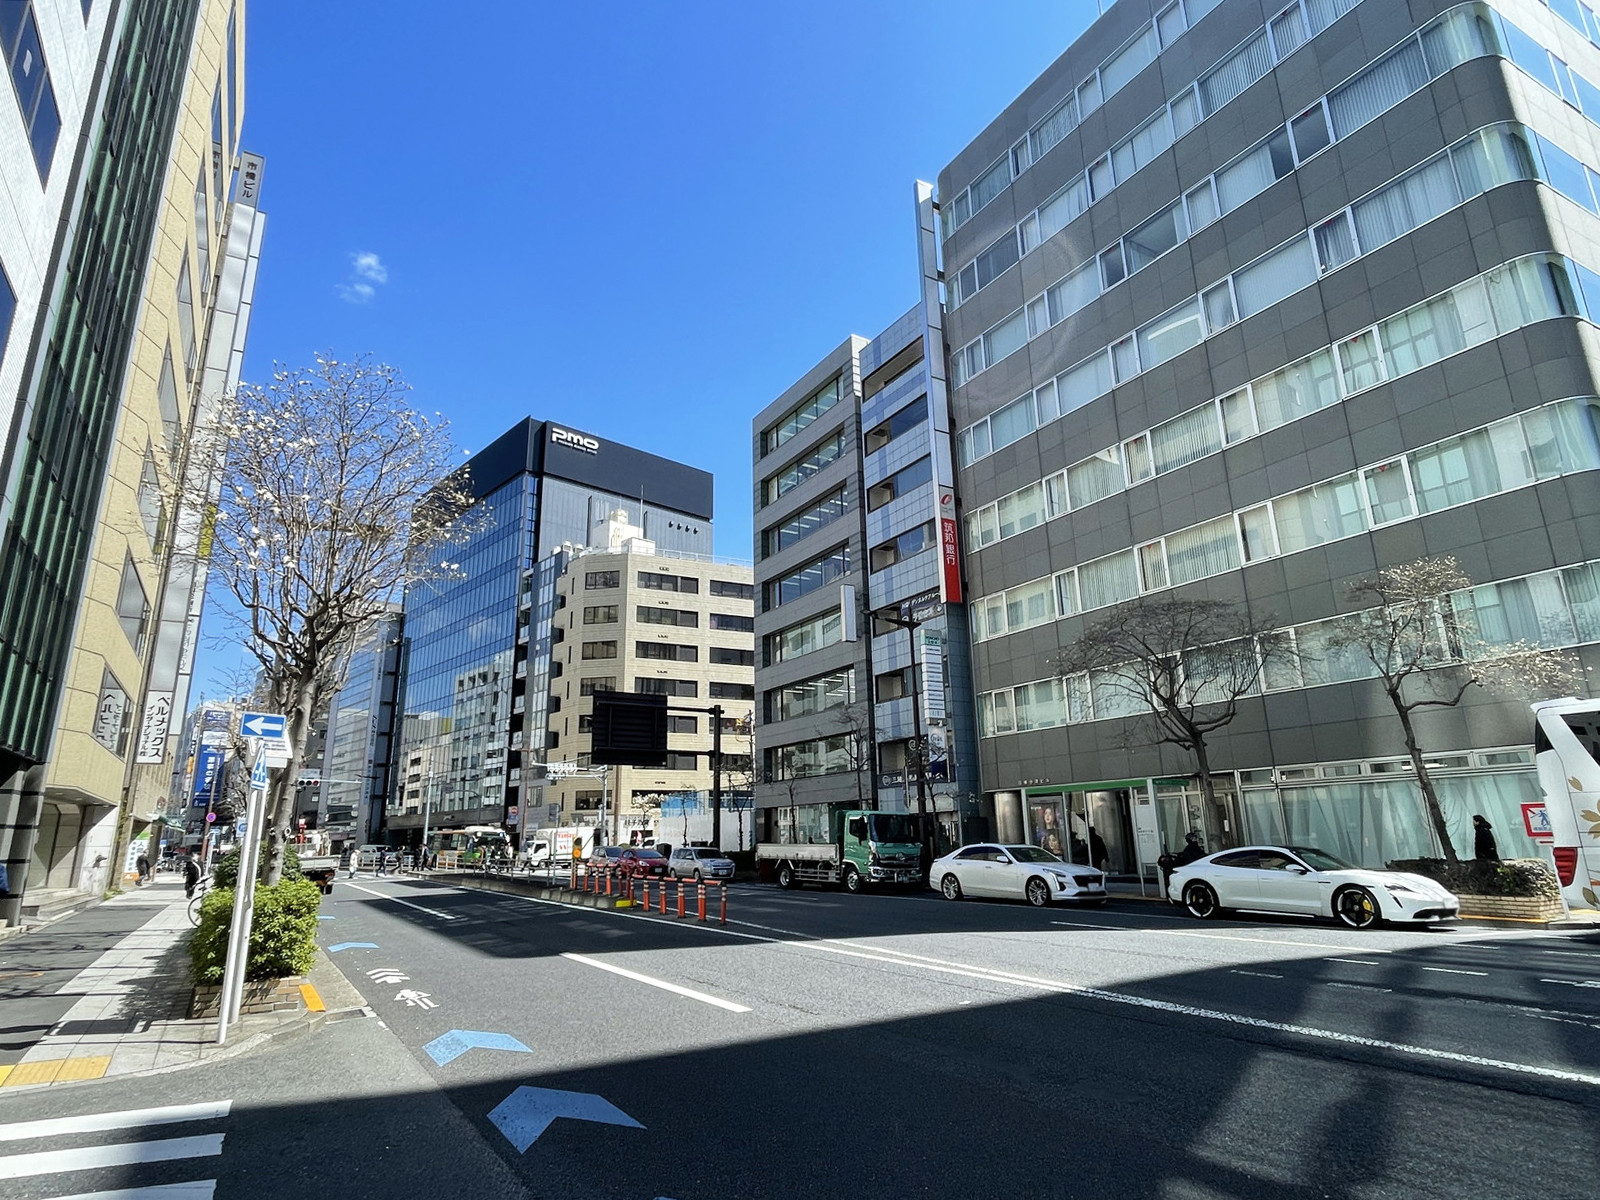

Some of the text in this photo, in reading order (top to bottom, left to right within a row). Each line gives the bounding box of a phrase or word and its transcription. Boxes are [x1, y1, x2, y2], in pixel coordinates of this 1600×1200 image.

[148, 696, 170, 758] ベルメックス
